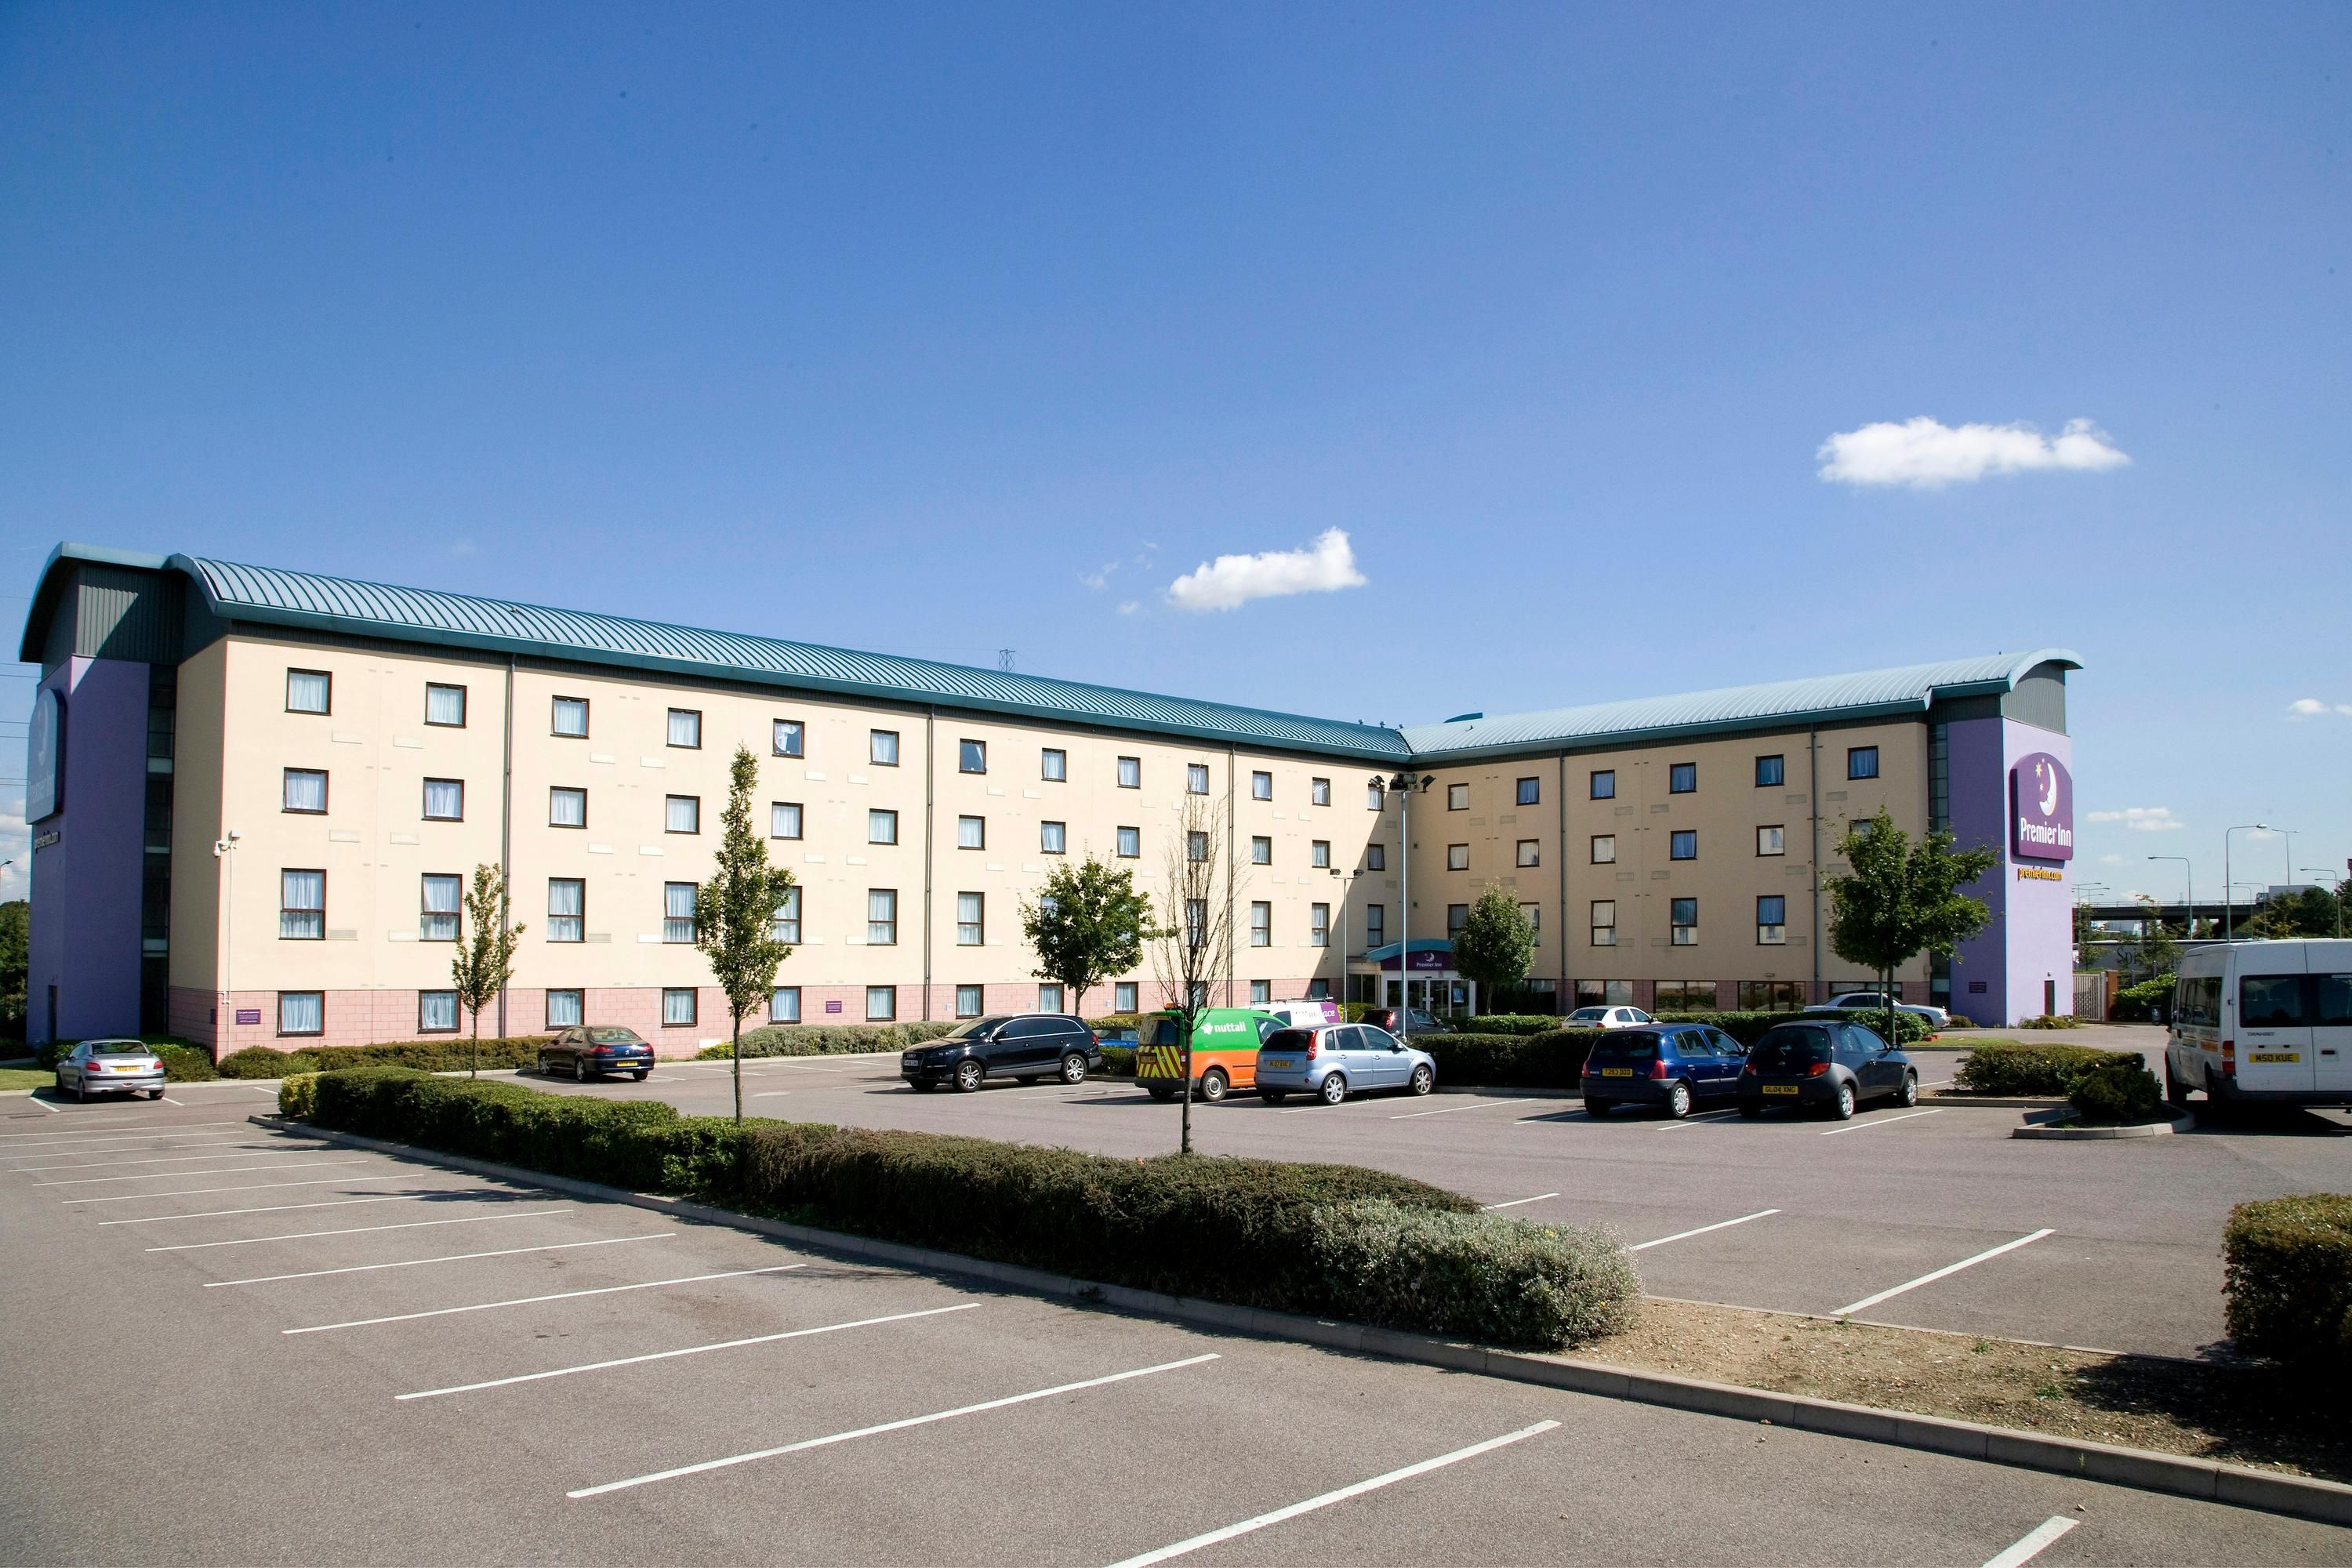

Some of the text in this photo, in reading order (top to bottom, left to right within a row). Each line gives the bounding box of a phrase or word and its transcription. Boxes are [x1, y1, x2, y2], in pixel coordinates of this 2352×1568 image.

[2020, 817, 2071, 847] Premier Inn
[2018, 867, 2062, 881] premierinn.com
[1214, 1021, 1247, 1033] nuttall
[2275, 1054, 2294, 1062] KUE
